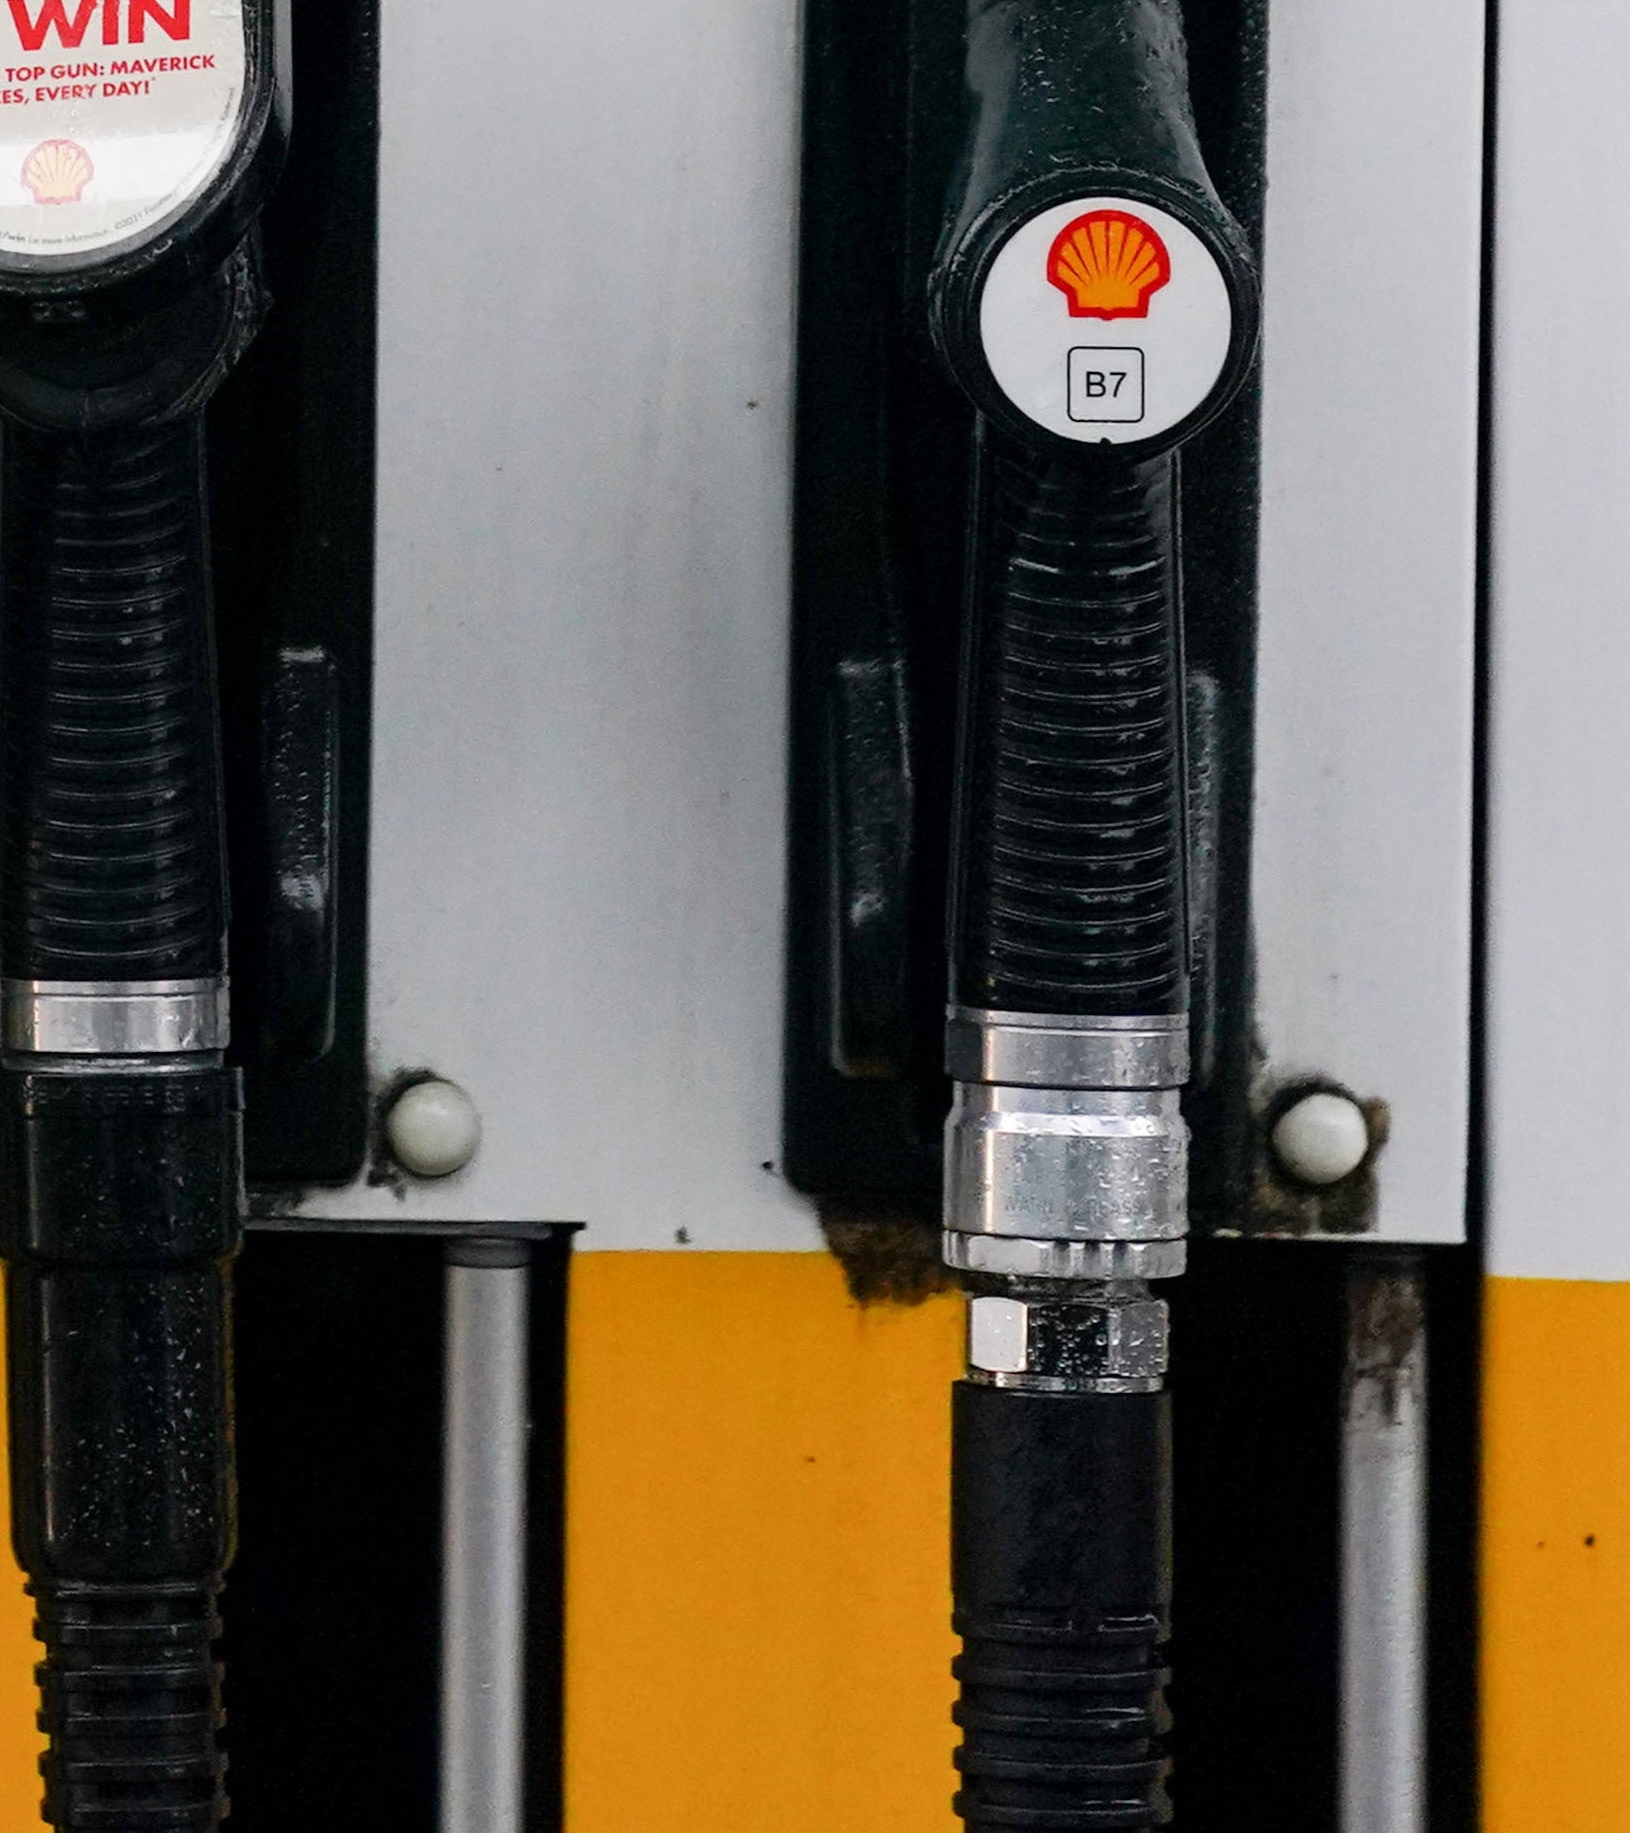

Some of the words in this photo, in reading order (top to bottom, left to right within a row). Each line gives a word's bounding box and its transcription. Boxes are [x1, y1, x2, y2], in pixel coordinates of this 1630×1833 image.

[5, 66, 46, 82] TOP
[50, 62, 105, 80] GUN:
[110, 54, 216, 75] MAVERICK
[35, 83, 97, 102] EVERY
[1085, 371, 1127, 398] B7
